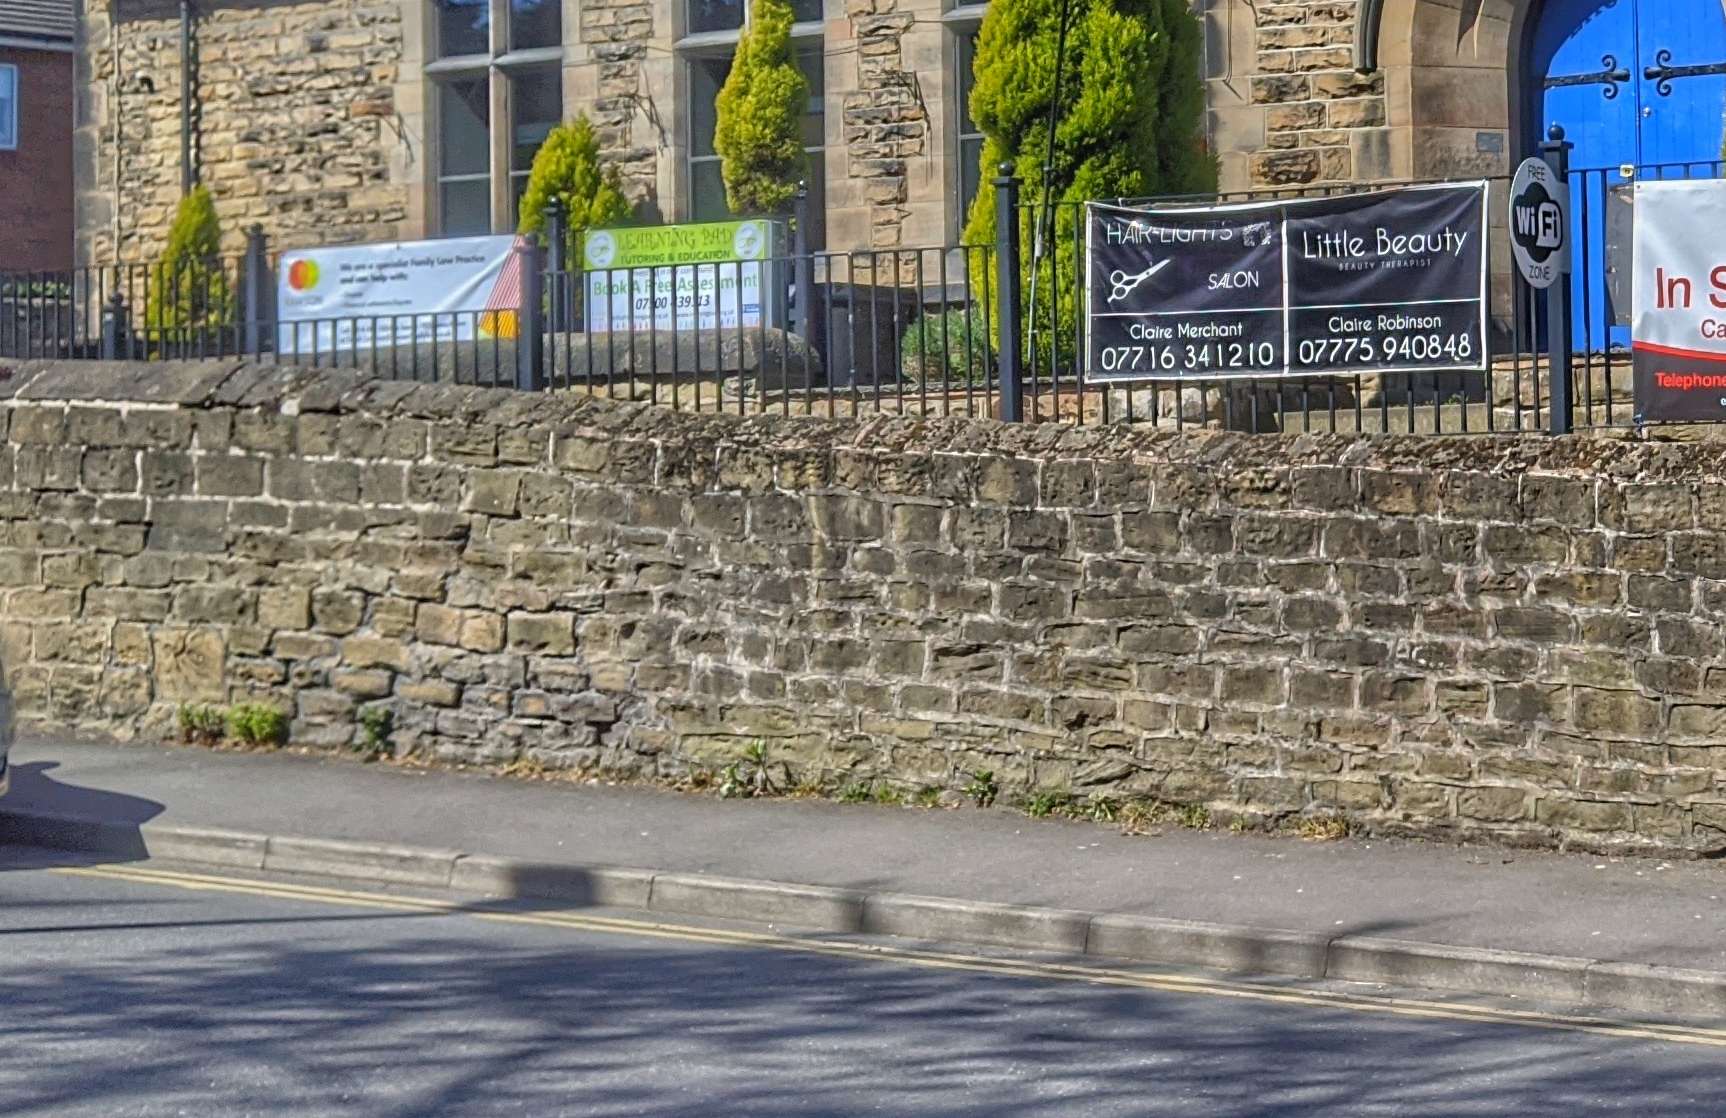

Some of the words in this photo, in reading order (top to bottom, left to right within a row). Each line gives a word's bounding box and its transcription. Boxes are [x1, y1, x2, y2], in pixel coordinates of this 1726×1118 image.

[1528, 165, 1546, 181] FREE
[618, 230, 696, 251] LEARNING
[702, 226, 732, 246] PAD
[1303, 229, 1366, 259] Little
[1376, 226, 1468, 257] Beauty
[410, 257, 434, 270] Family
[436, 256, 454, 266] Law
[456, 254, 486, 265] Practice
[620, 252, 664, 264] TUTORING
[667, 252, 674, 262] &
[677, 250, 730, 262] EDUCATION
[1338, 261, 1375, 271] BEAUTY
[1381, 258, 1432, 269] THERAPIST
[1208, 270, 1260, 290] SALON
[1529, 265, 1550, 280] ZONE
[1656, 268, 1692, 308] In
[1130, 324, 1172, 340] Claire
[1178, 322, 1242, 338] Merchant
[1328, 316, 1372, 332] Claire
[1378, 314, 1442, 331] Robinson
[1102, 346, 1176, 370] 07716
[1184, 342, 1274, 368] 341210
[1300, 338, 1374, 364] 07775
[1383, 333, 1472, 361] 940848
